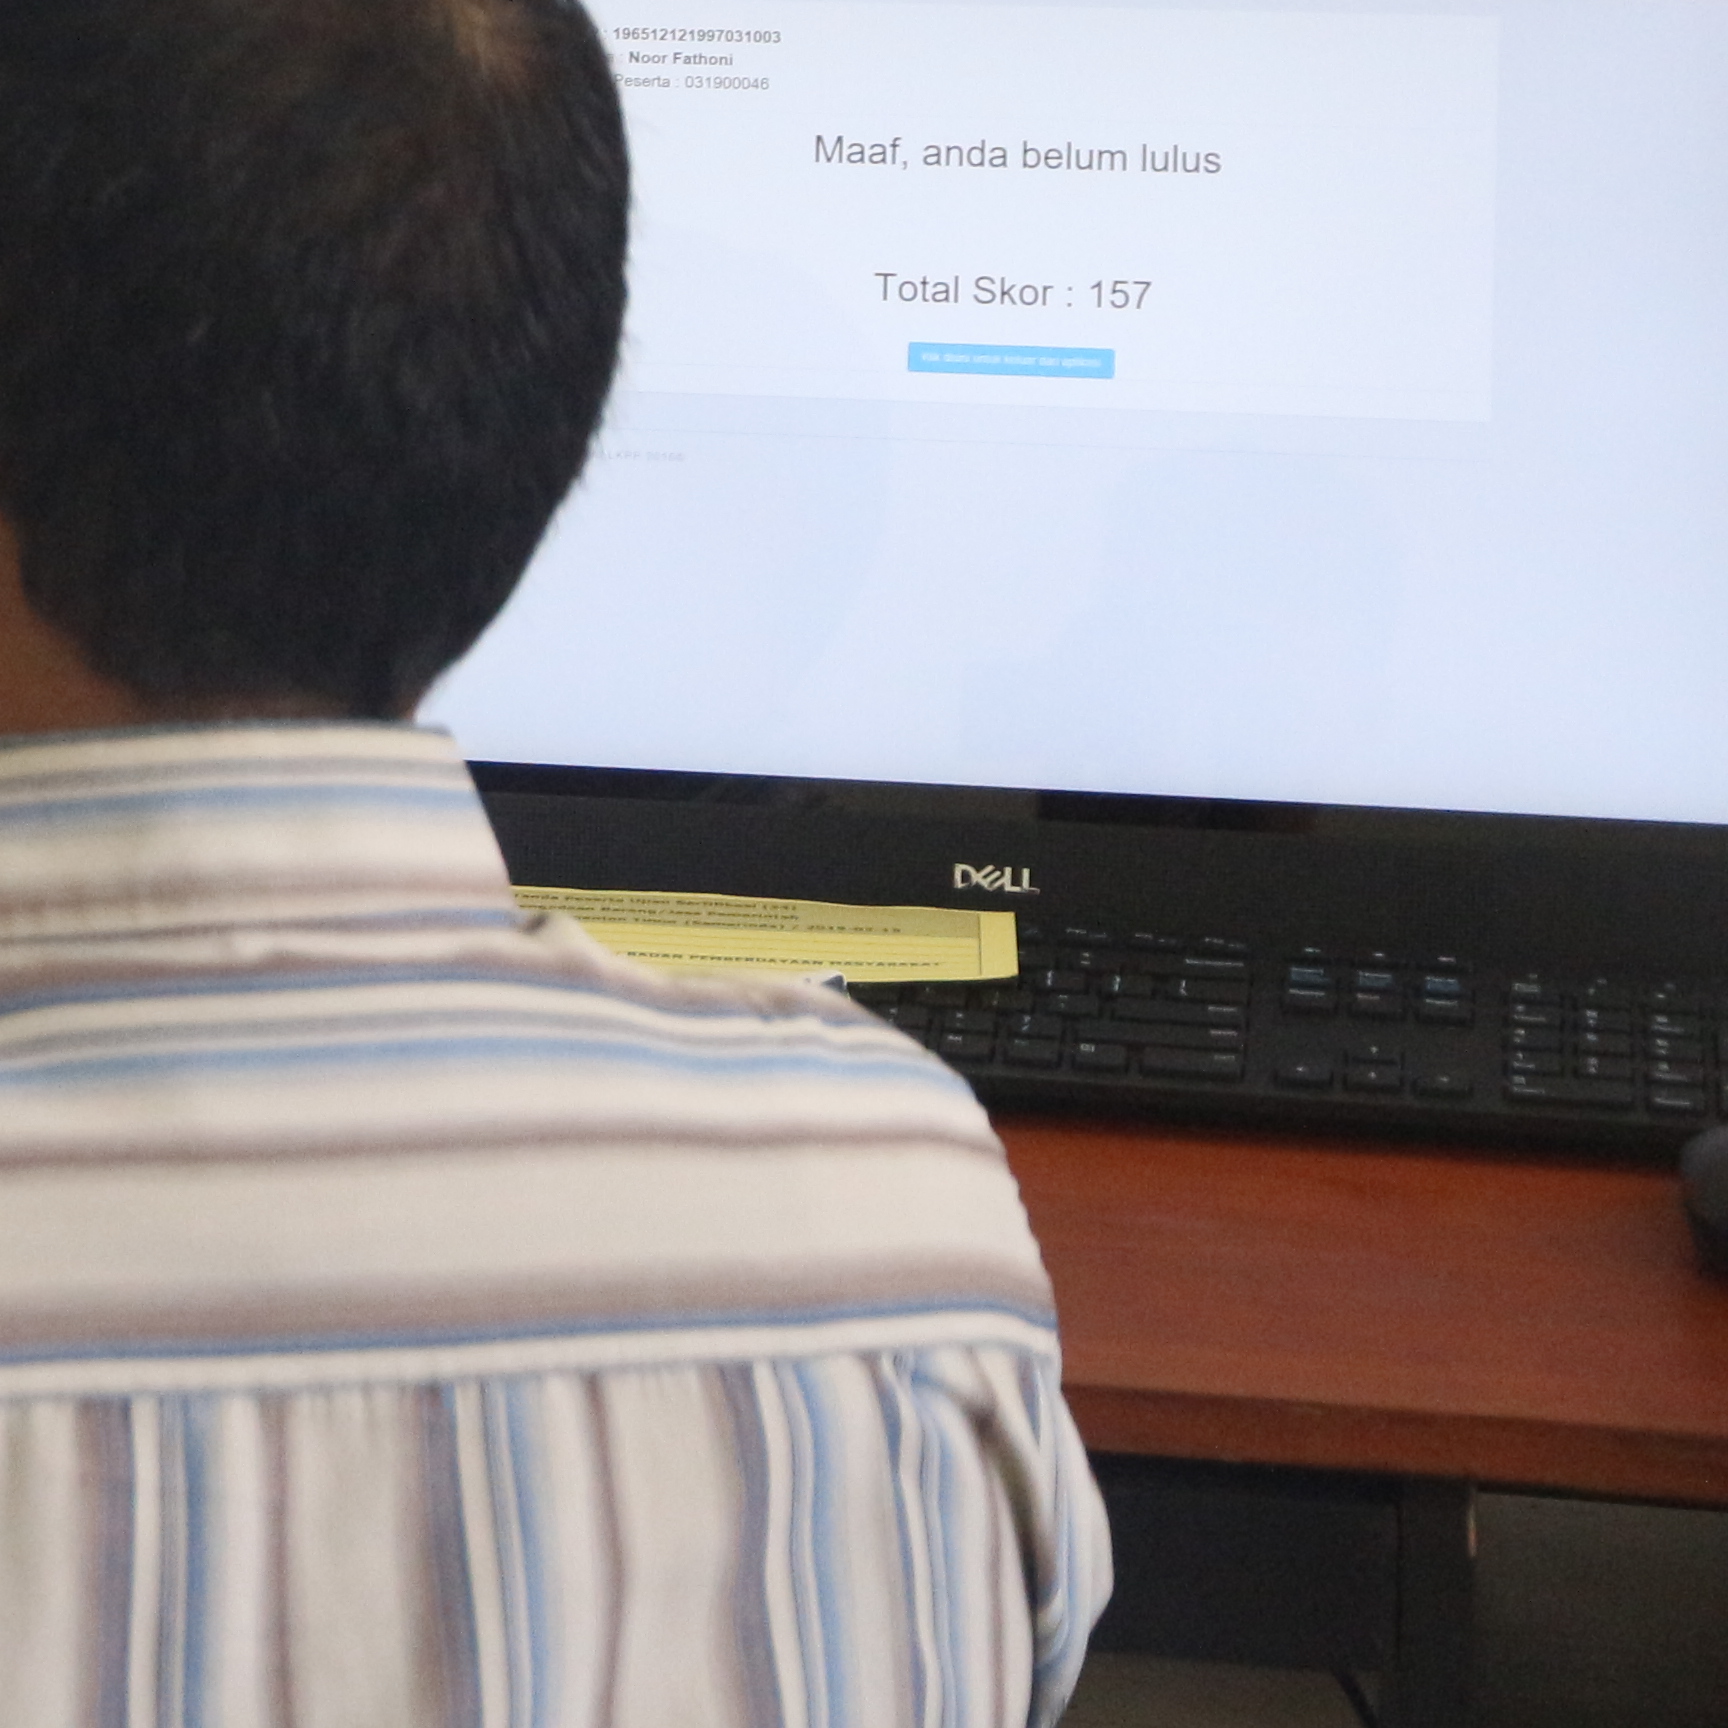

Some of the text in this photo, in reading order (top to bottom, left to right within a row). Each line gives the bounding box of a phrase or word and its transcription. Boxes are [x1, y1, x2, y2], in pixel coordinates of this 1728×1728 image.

[628, 51, 669, 65] Noor
[672, 52, 734, 66] Fathoni
[684, 75, 770, 90] 031900046
[813, 133, 1223, 175] Maaf, anda belum lulus
[874, 271, 960, 304] Total
[972, 274, 1054, 306] Skor
[1088, 278, 1153, 310] 157
[952, 862, 1040, 895] DELL
